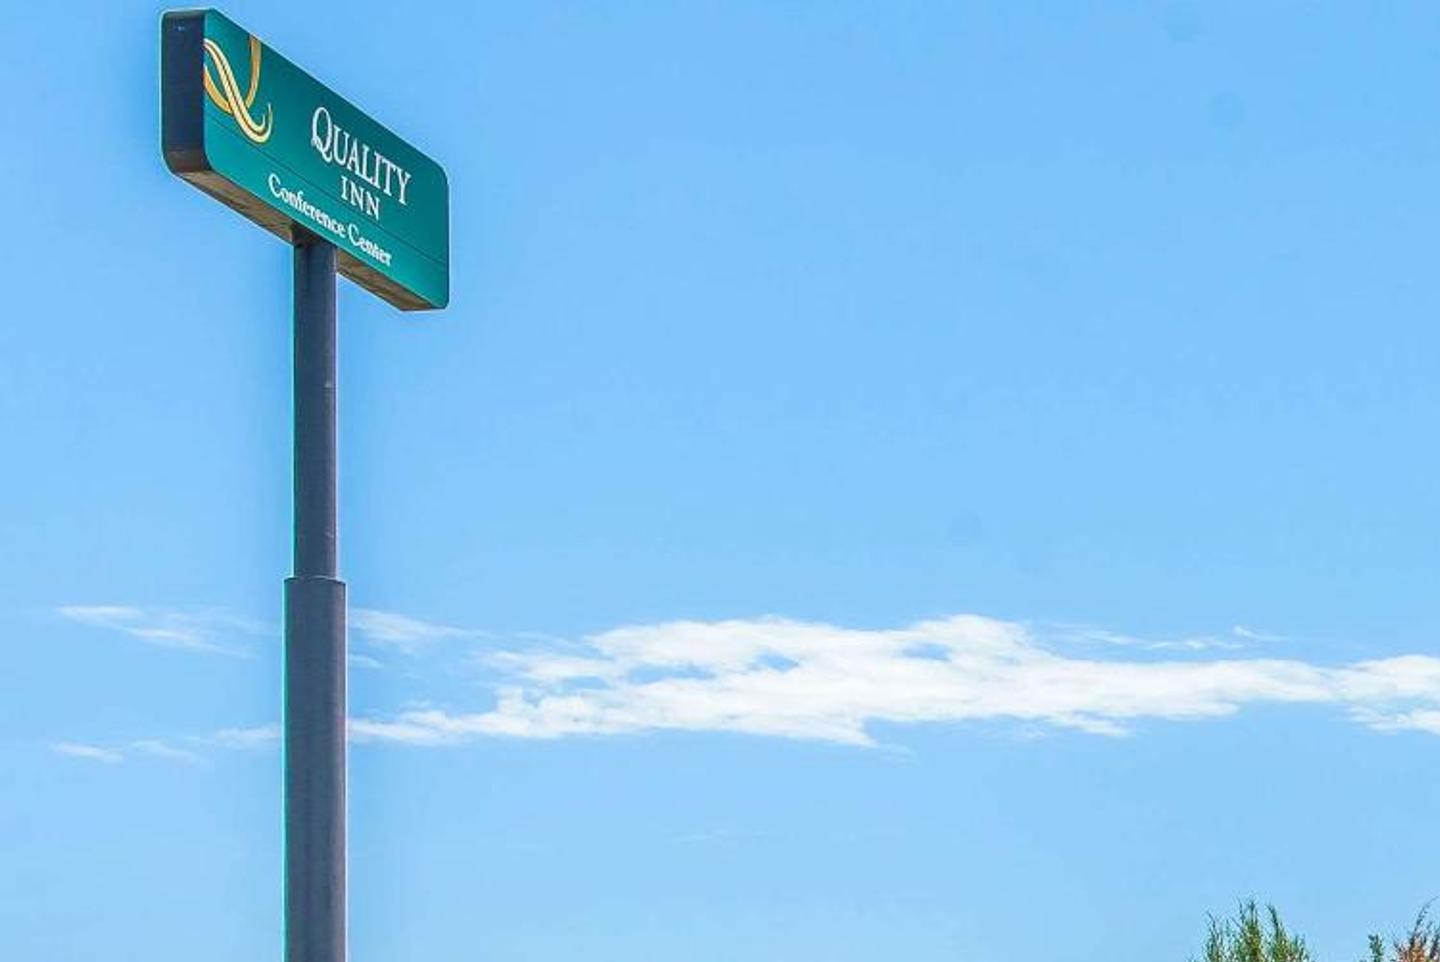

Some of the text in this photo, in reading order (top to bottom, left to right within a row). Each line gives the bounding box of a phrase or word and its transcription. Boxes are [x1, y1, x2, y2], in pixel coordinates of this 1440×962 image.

[311, 107, 411, 205] QUALITY
[341, 176, 380, 220] INN
[268, 173, 392, 266] Conference Center
